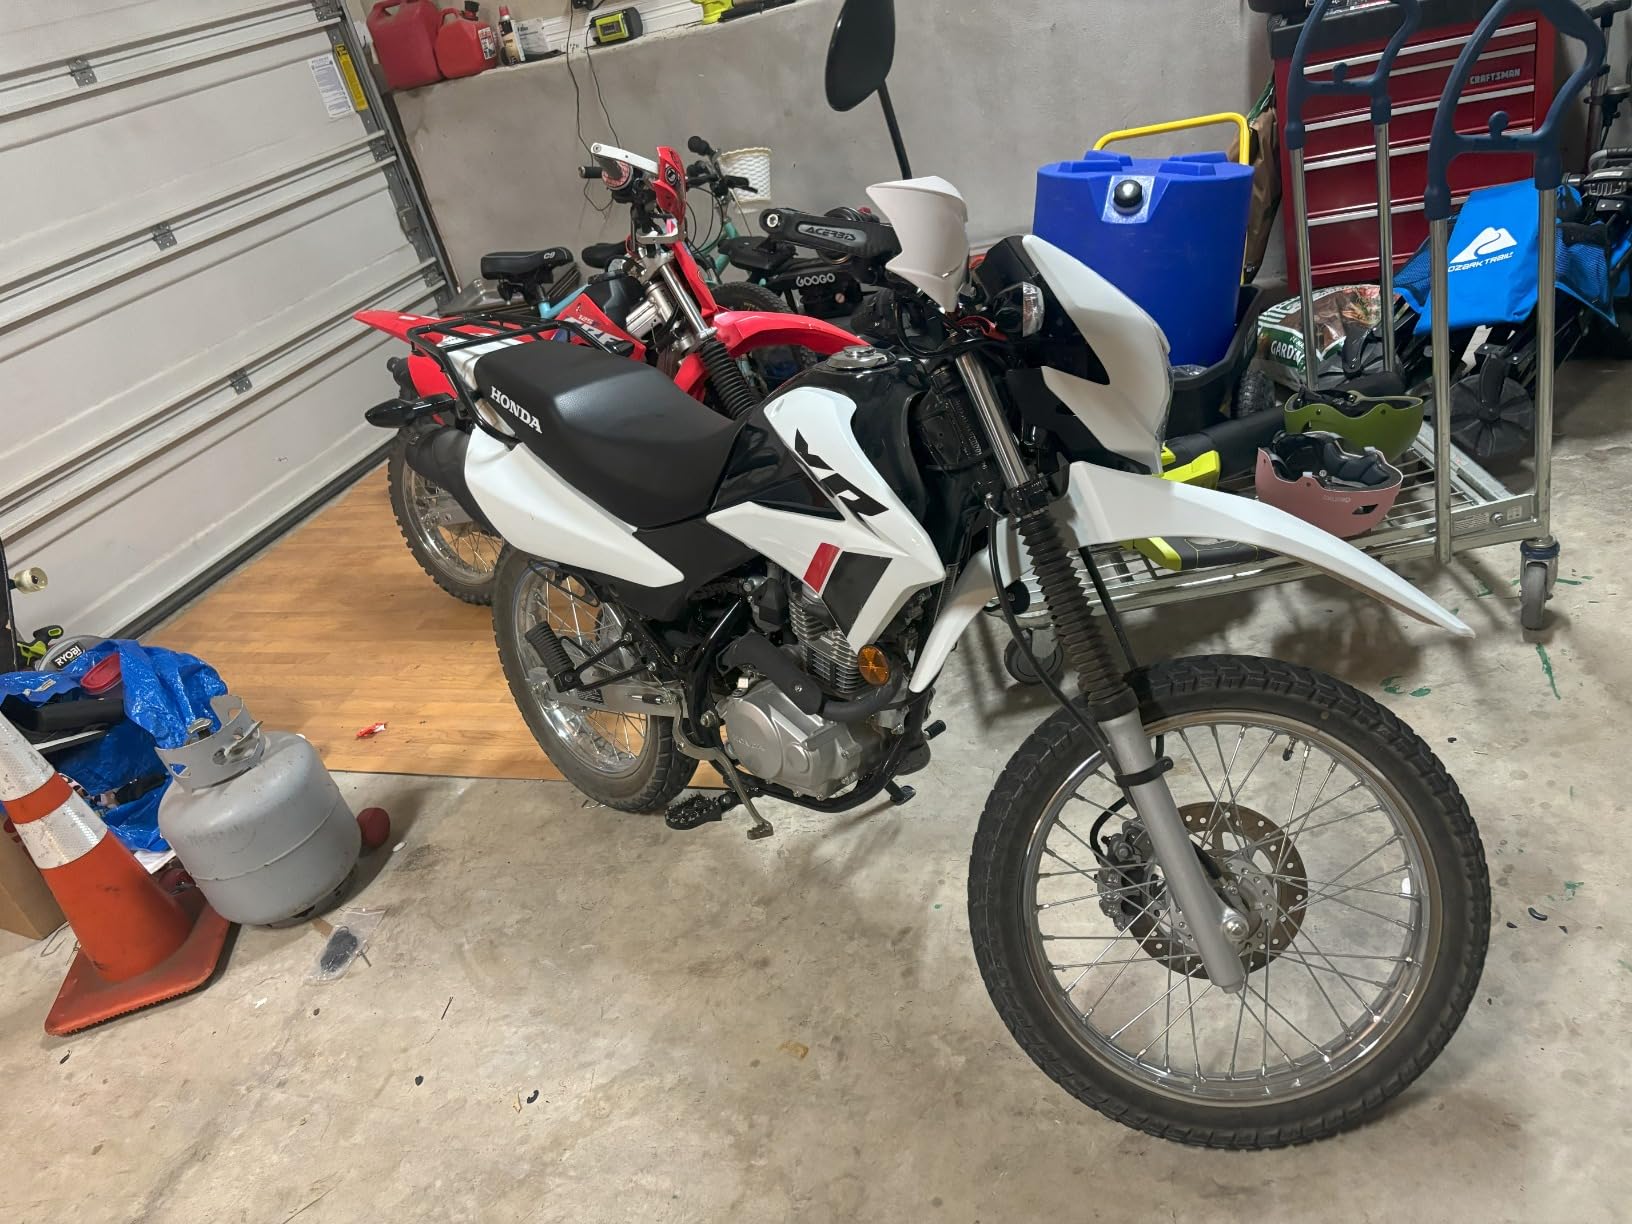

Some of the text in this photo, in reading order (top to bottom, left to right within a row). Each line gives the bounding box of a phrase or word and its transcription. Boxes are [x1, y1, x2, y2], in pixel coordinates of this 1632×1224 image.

[1470, 68, 1521, 85] CRAFTSMAN
[805, 226, 857, 242] ACERBIS
[1447, 261, 1484, 273] OZARK
[490, 385, 543, 434] HONDA
[54, 645, 83, 667] RYOBI
